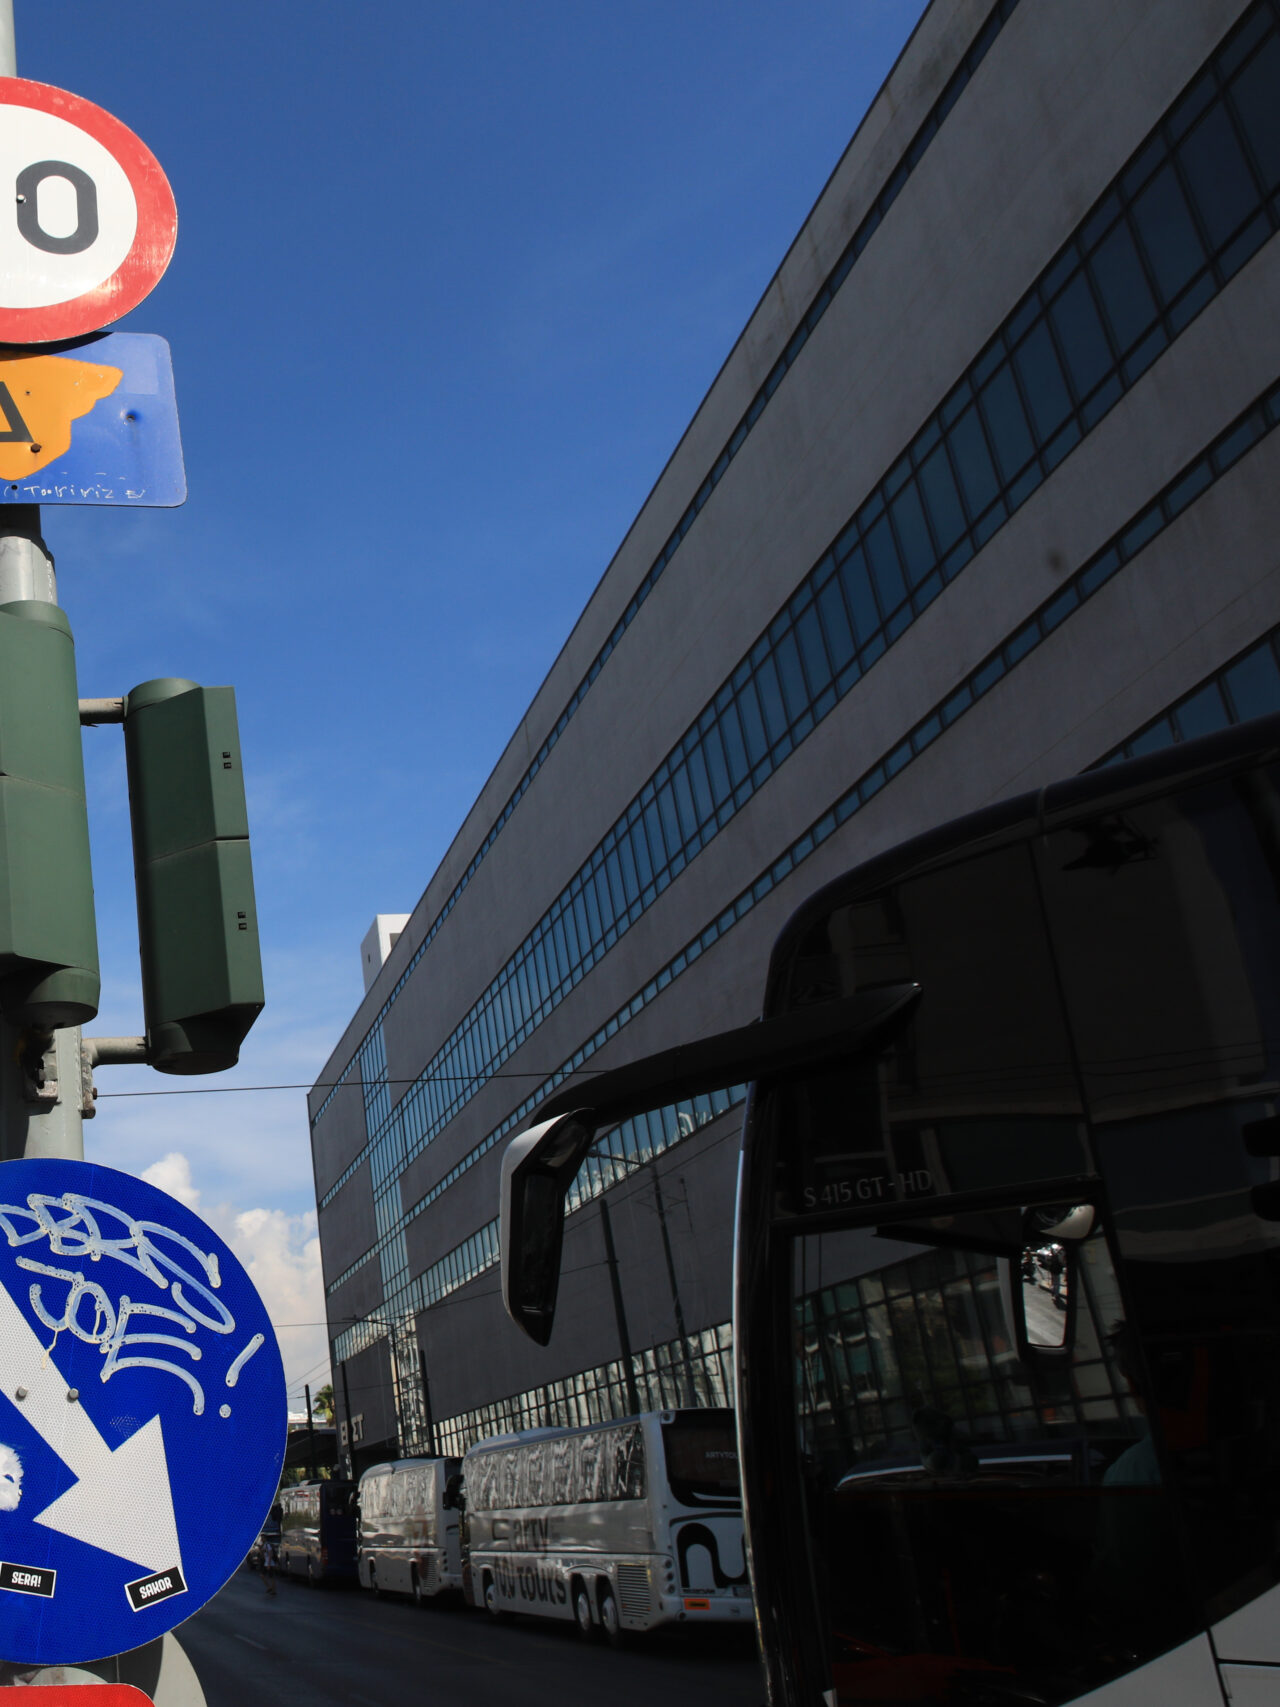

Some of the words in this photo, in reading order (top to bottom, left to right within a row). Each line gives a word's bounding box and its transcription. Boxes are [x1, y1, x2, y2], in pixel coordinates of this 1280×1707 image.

[803, 1187, 817, 1208] S
[820, 1181, 852, 1206] 415
[11, 1571, 42, 1588] SERA!
[139, 1576, 173, 1600] SAKOR
